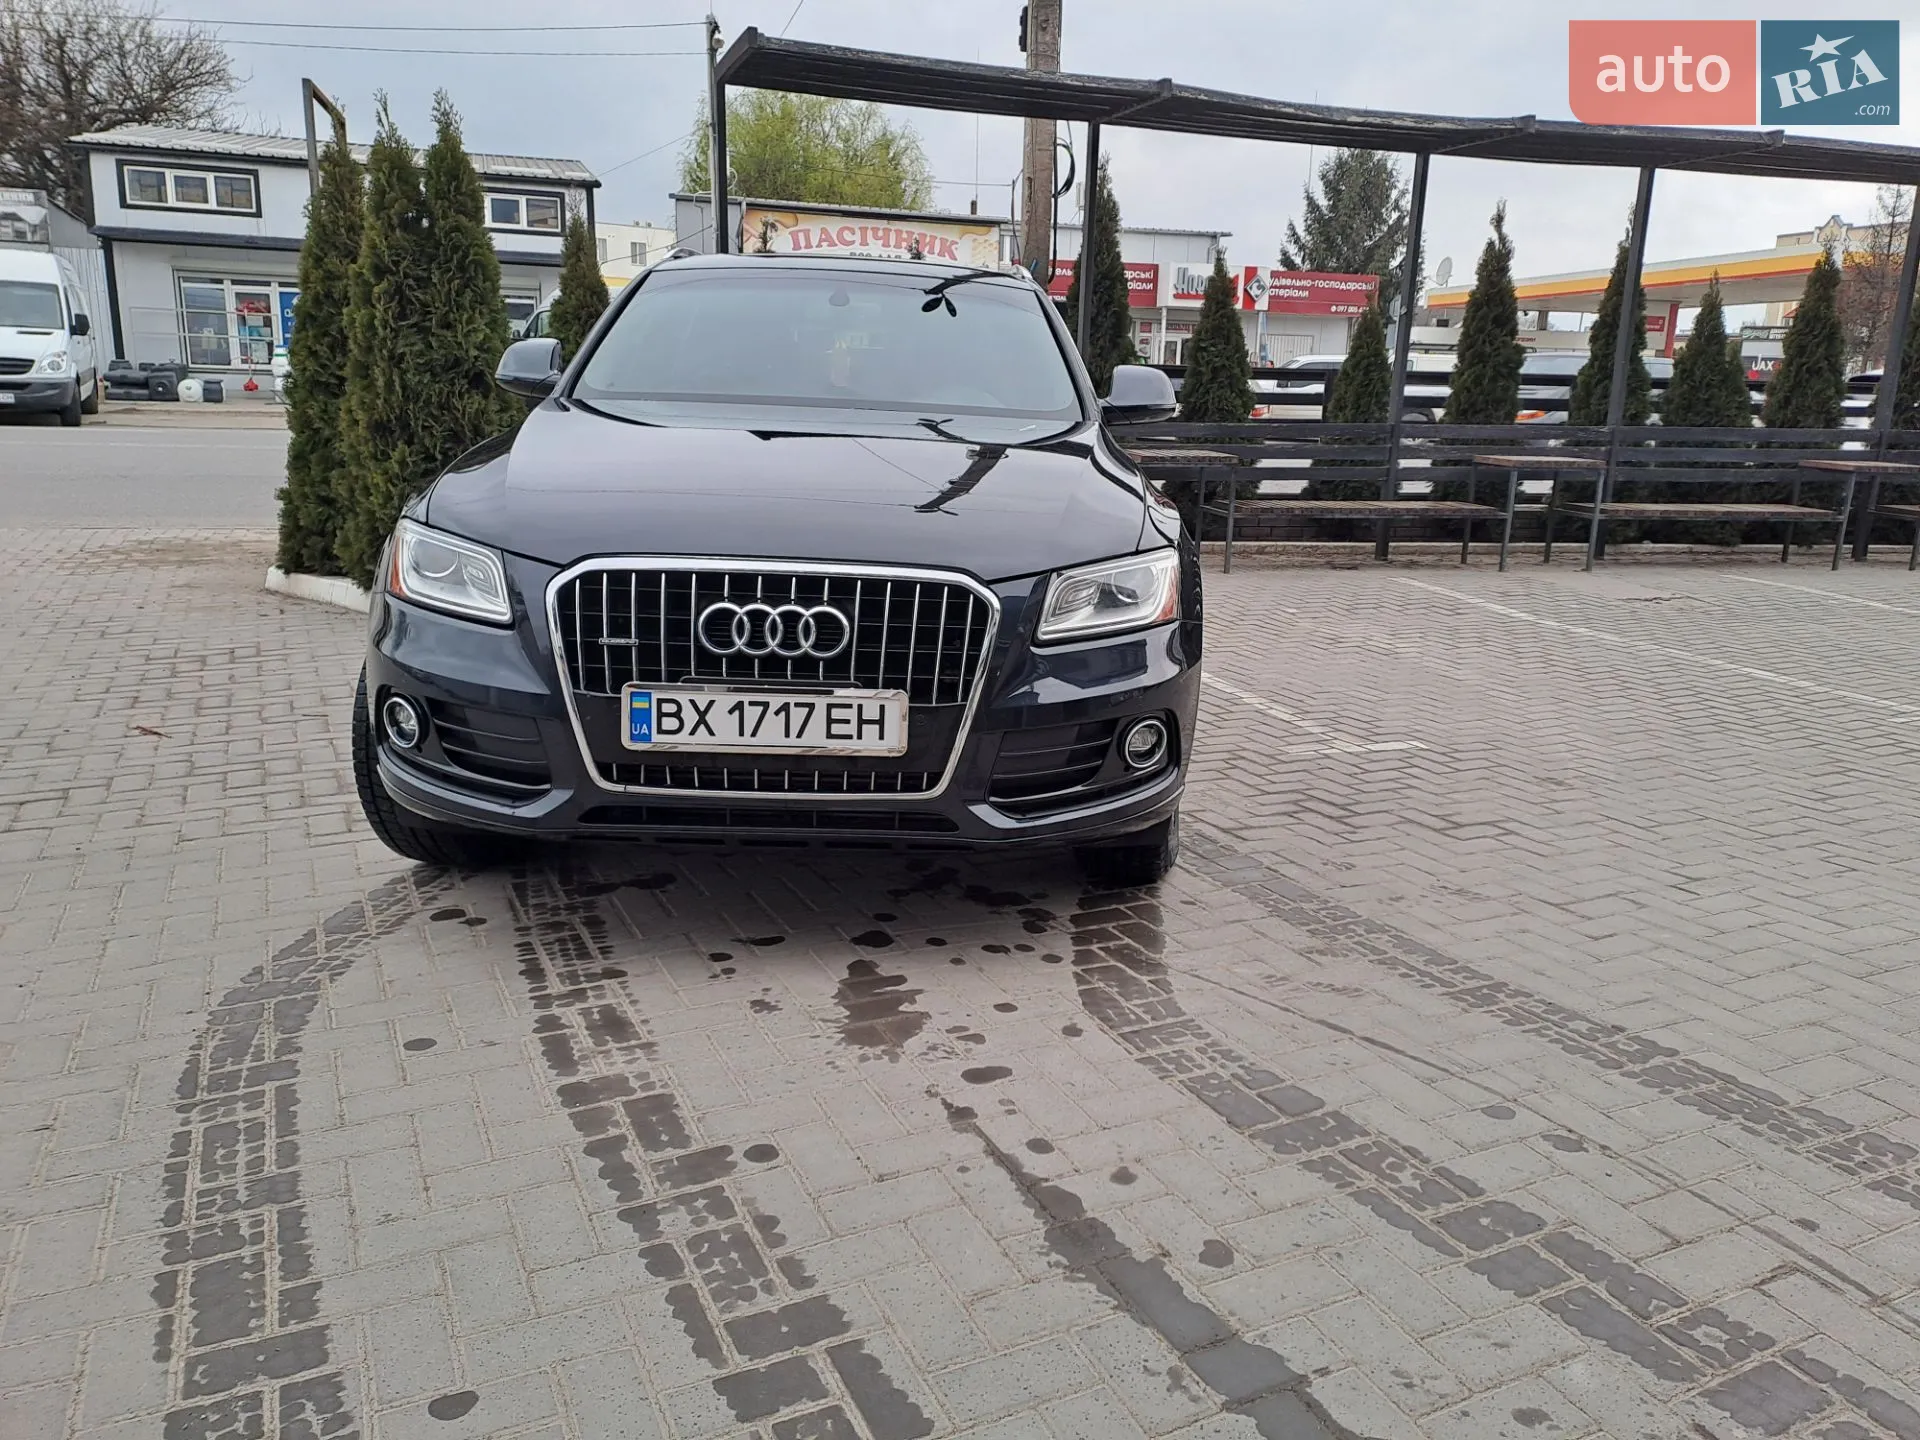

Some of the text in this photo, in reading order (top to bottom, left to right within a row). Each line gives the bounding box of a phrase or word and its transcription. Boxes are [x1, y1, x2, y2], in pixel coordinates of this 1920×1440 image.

[788, 225, 960, 261] ПАСІЧНИК
[1268, 276, 1375, 291] удівельно-господарські
[1268, 287, 1309, 299] атеріали
[632, 697, 886, 741] UA BX 1717 EH
